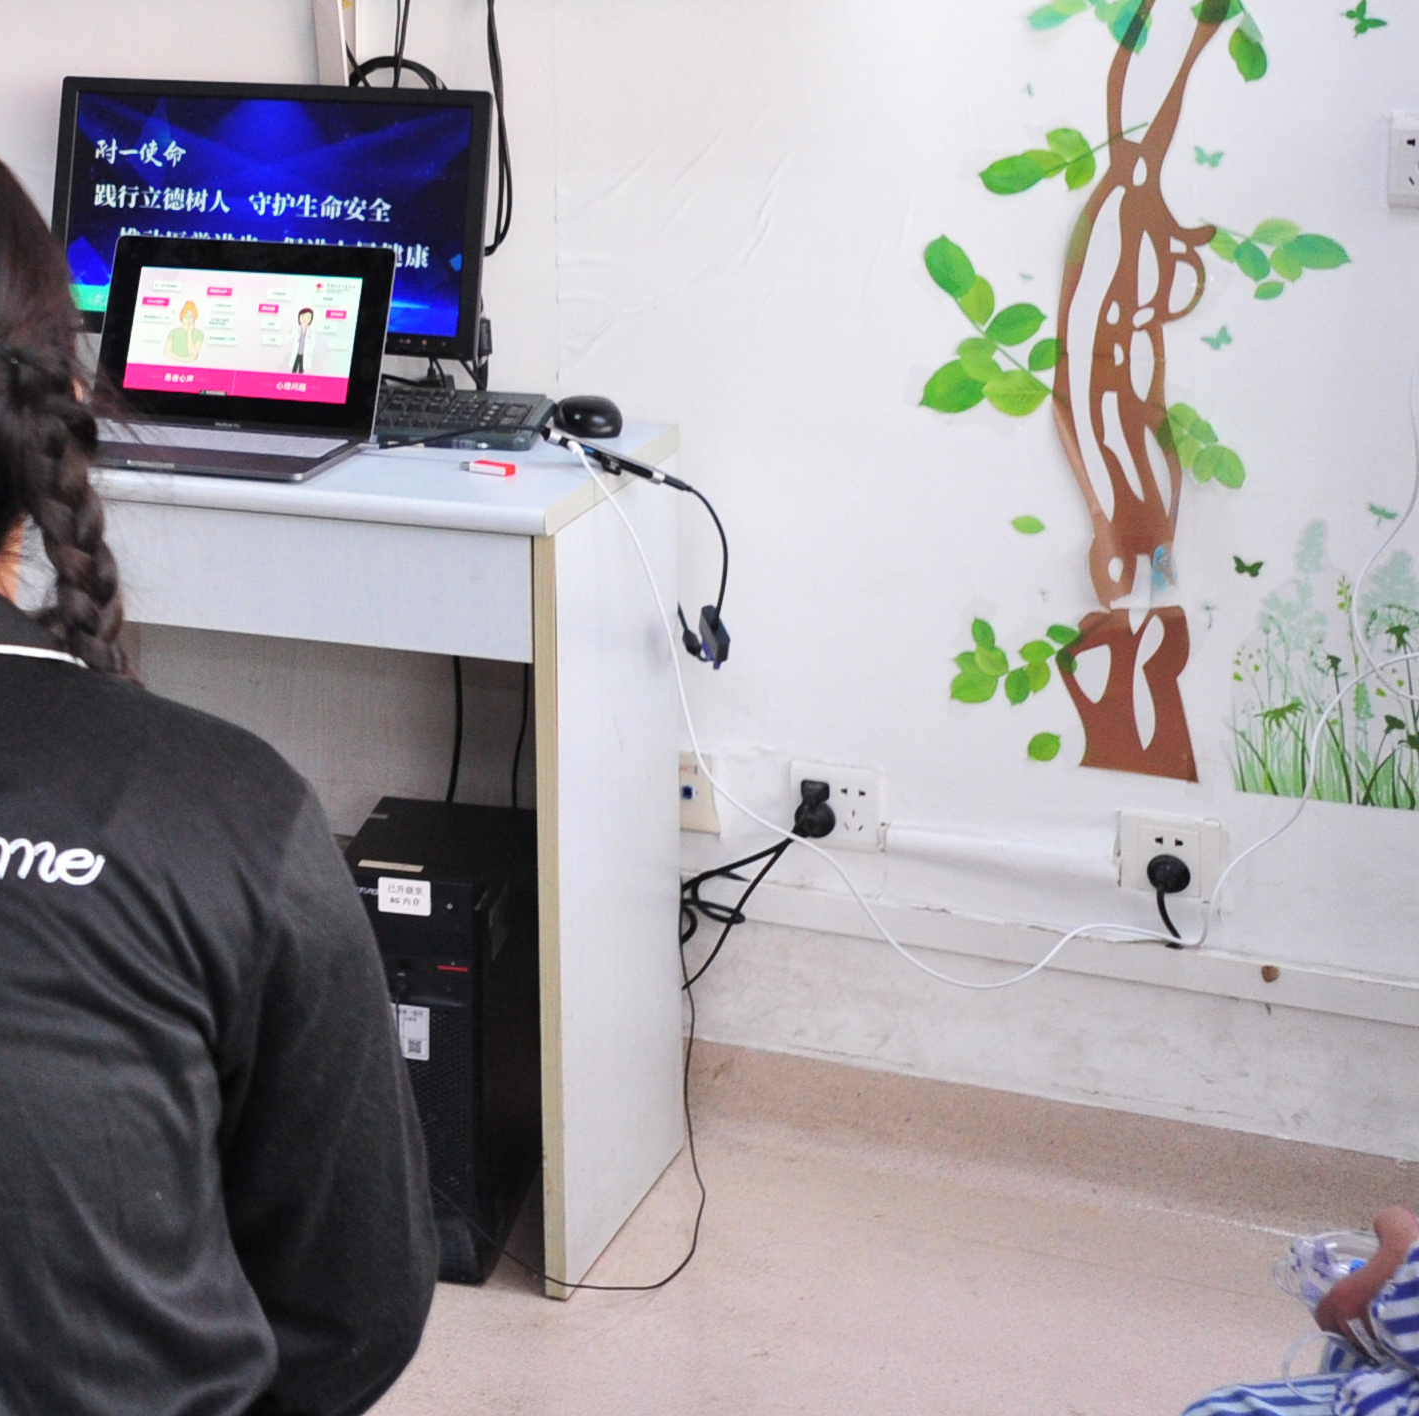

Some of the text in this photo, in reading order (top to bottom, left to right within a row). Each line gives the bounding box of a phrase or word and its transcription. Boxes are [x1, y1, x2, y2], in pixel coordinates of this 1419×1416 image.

[94, 138, 186, 168] 附一使命
[93, 184, 393, 223] 践行立德树人 守护生命安全
